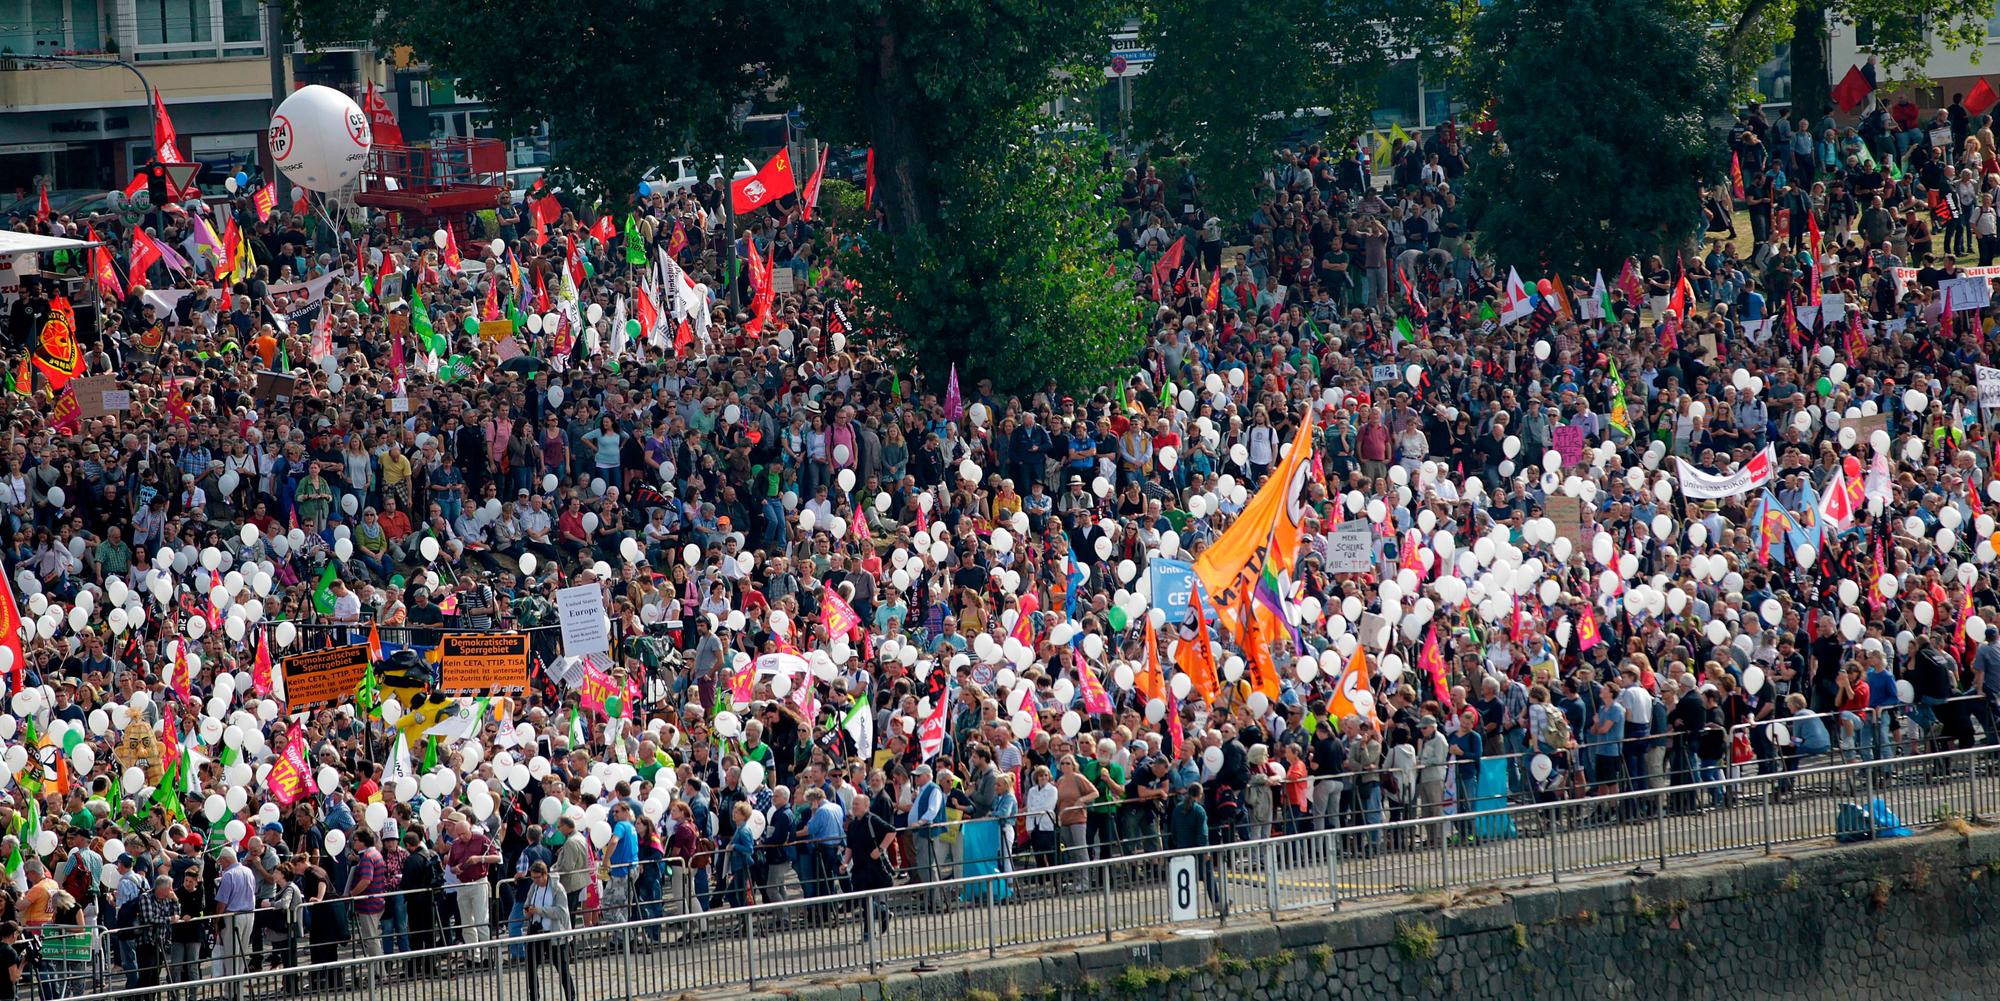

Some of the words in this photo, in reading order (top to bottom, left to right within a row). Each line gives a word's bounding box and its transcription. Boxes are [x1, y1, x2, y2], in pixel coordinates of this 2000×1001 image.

[569, 606, 599, 618] Europe
[451, 638, 518, 647] Demokratisches
[460, 646, 509, 656] Sperrgebiet
[292, 649, 360, 667] Demokratisches
[302, 657, 353, 673] Sperrgebiet
[464, 660, 485, 668] CETA,
[487, 659, 506, 667] TTIP,
[493, 667, 525, 676] untersagt
[288, 678, 305, 686] Kein
[308, 674, 330, 683] CETA,
[331, 670, 351, 680] TTIP,
[289, 683, 325, 693] Freihandel
[306, 689, 328, 697] Zutritt
[502, 684, 525, 693] attac
[271, 755, 304, 797] ETA!
[1177, 868, 1191, 910] 8
